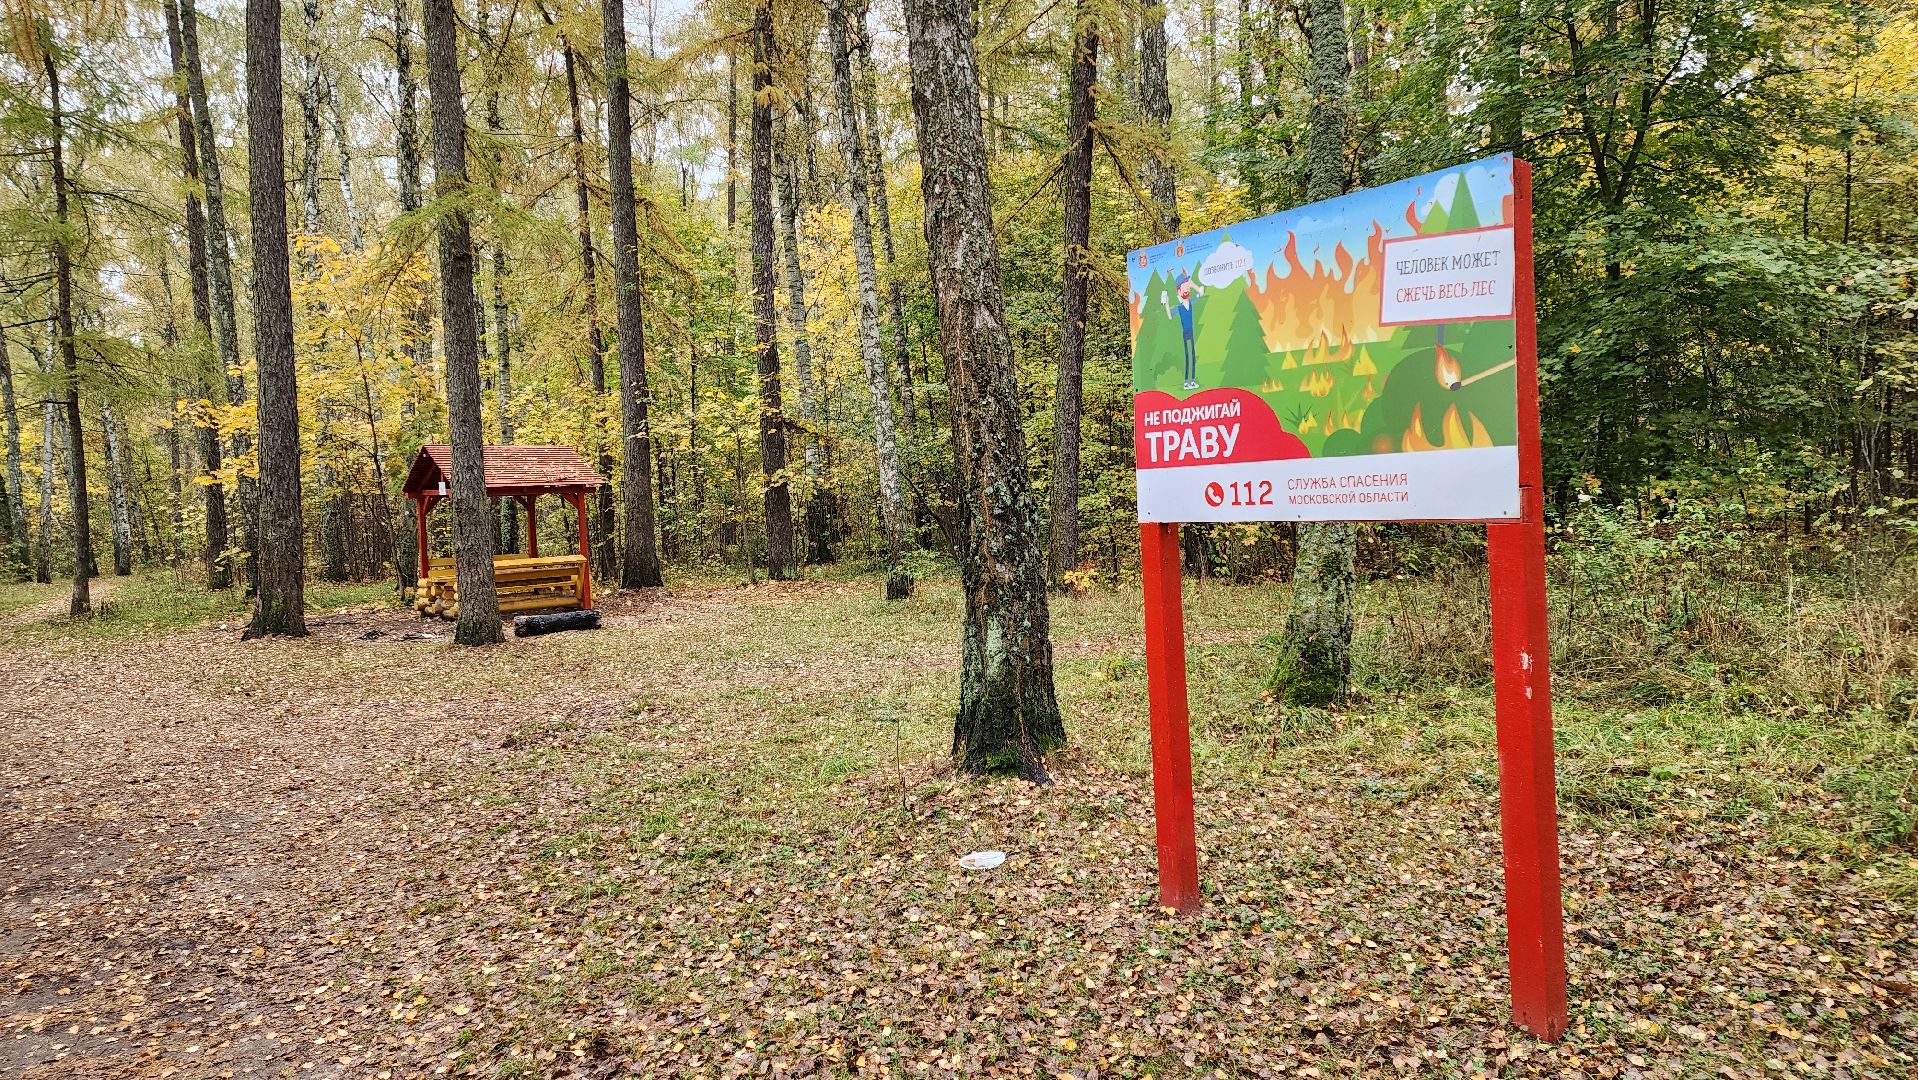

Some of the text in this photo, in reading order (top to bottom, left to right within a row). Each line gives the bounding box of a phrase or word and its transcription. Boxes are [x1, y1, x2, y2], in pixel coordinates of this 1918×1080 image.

[1396, 250, 1501, 275] ЧЕЛОВЕК МОЖЕТ
[1396, 280, 1496, 303] СЖЕЧЬ ВЕСЬ ЛЕС
[1144, 398, 1241, 426] НЕ ПОДЖИГАЙ
[1144, 423, 1240, 462] ТРАВУ
[1230, 480, 1273, 506] 112
[1287, 473, 1408, 490] СЛУЖБА СПАСЕНИЯ
[1288, 491, 1409, 505] МОСКОВСКОЙ ОБЛАСТИ
